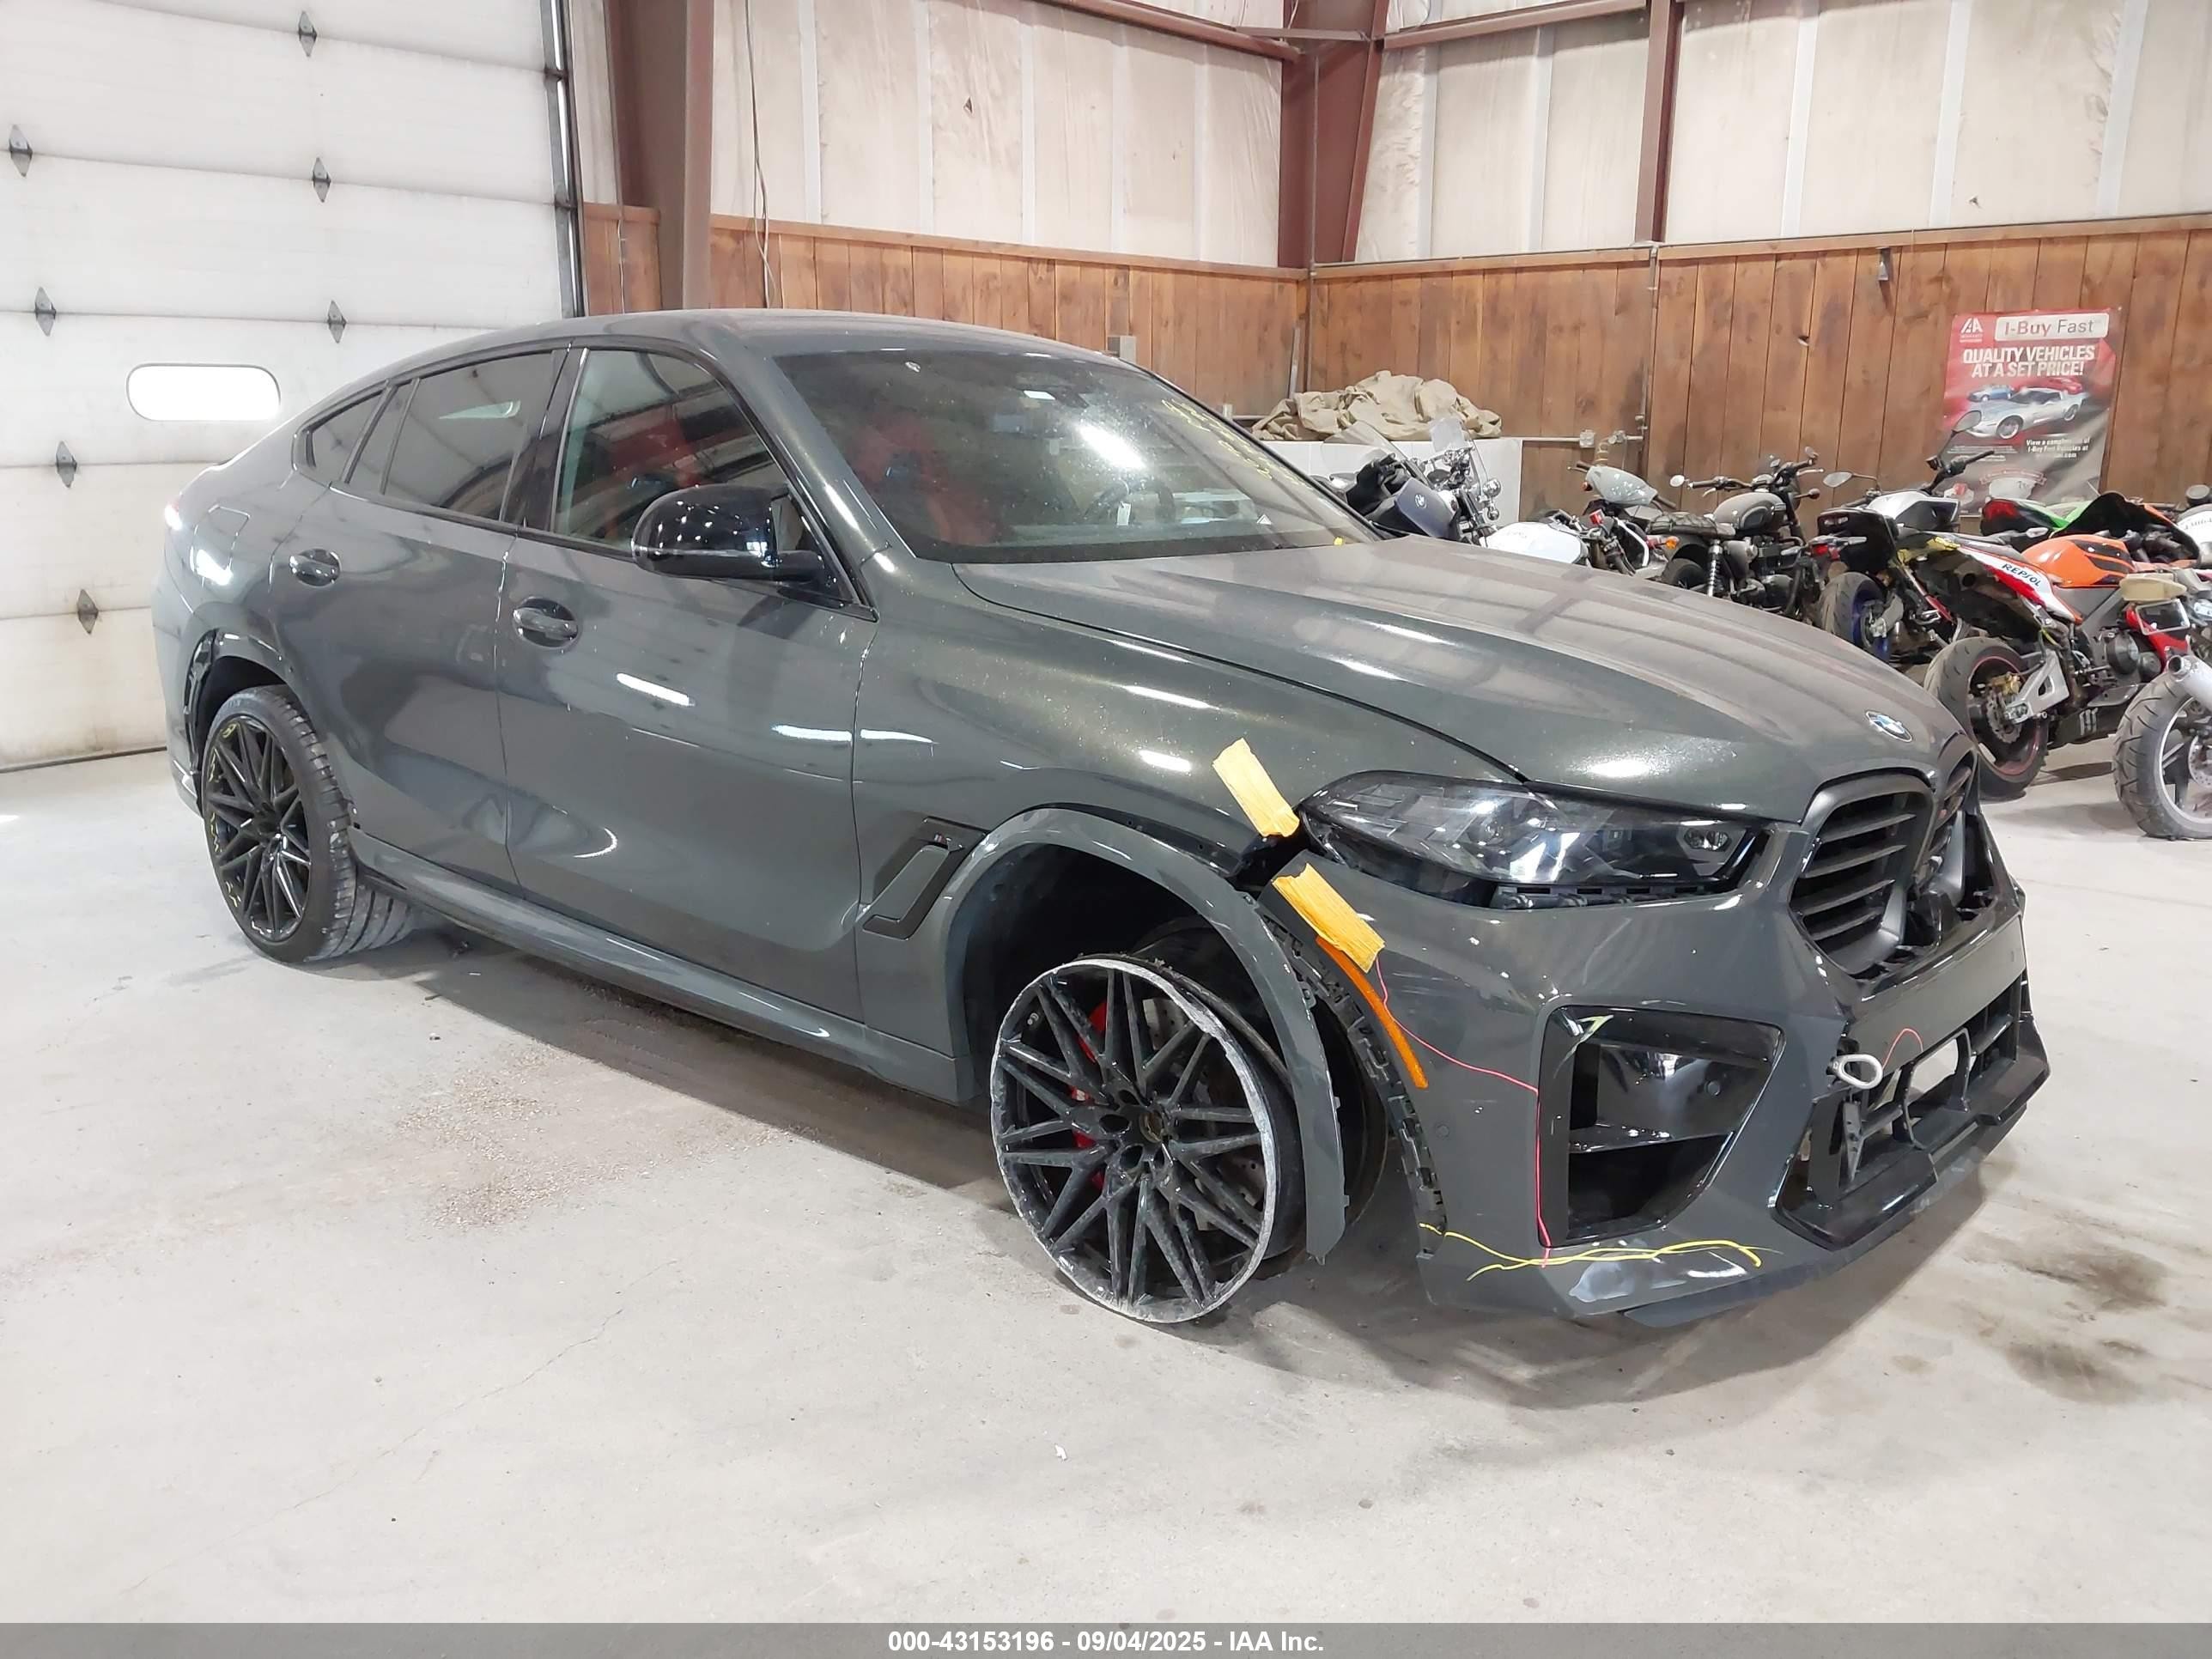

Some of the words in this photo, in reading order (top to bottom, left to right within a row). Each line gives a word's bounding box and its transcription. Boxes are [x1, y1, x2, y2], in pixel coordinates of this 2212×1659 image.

[2005, 320, 2051, 337] I-Buy
[2057, 319, 2094, 334] Fast
[1963, 347, 2024, 363] QUALITY
[2025, 345, 2095, 362] VEHICLES
[1972, 363, 1992, 378] AT
[1993, 363, 2004, 377] A
[2007, 362, 2035, 377] SET
[2037, 361, 2084, 376] PRICE!
[2002, 563, 2042, 586] REPSOL
